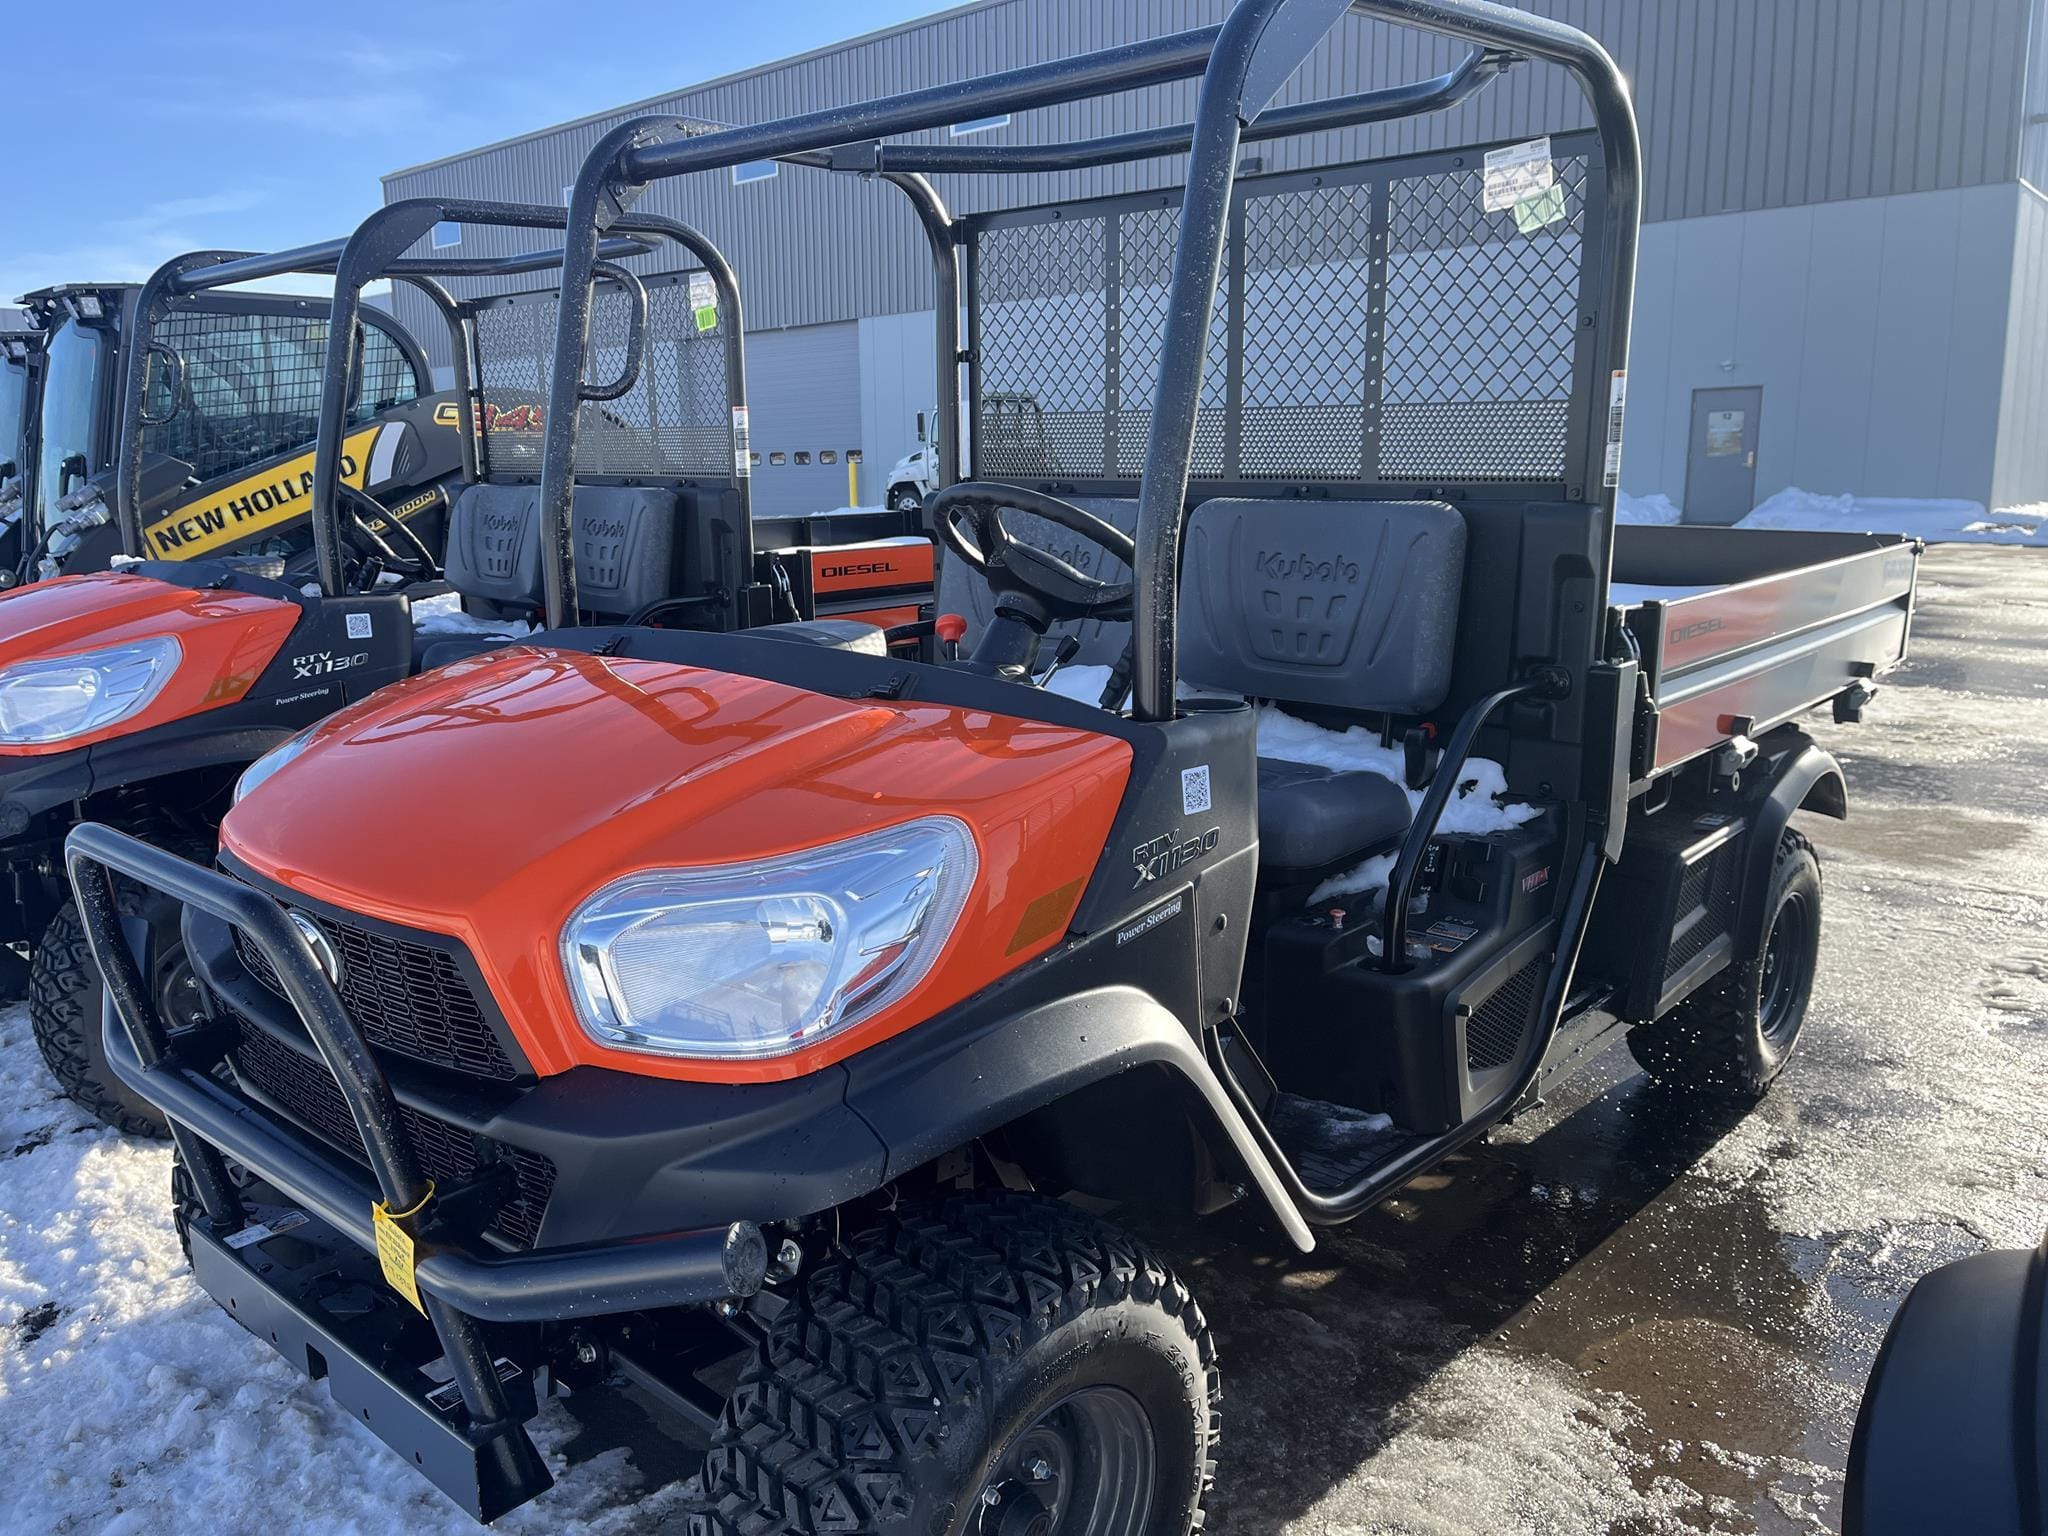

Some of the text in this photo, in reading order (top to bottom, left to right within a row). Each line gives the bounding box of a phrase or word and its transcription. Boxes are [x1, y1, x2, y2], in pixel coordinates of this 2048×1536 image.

[154, 455, 357, 552] NEW HOLLAD
[821, 562, 899, 578] DIESEL
[1256, 550, 1360, 584] Kubota
[1670, 616, 1728, 645] DIESEL
[293, 651, 332, 666] RTV
[293, 652, 369, 680] X1130
[275, 687, 330, 706] Power Steering
[1132, 826, 1221, 889] X1130
[1133, 828, 1180, 863] RTV
[1117, 900, 1182, 945] Power Steering
